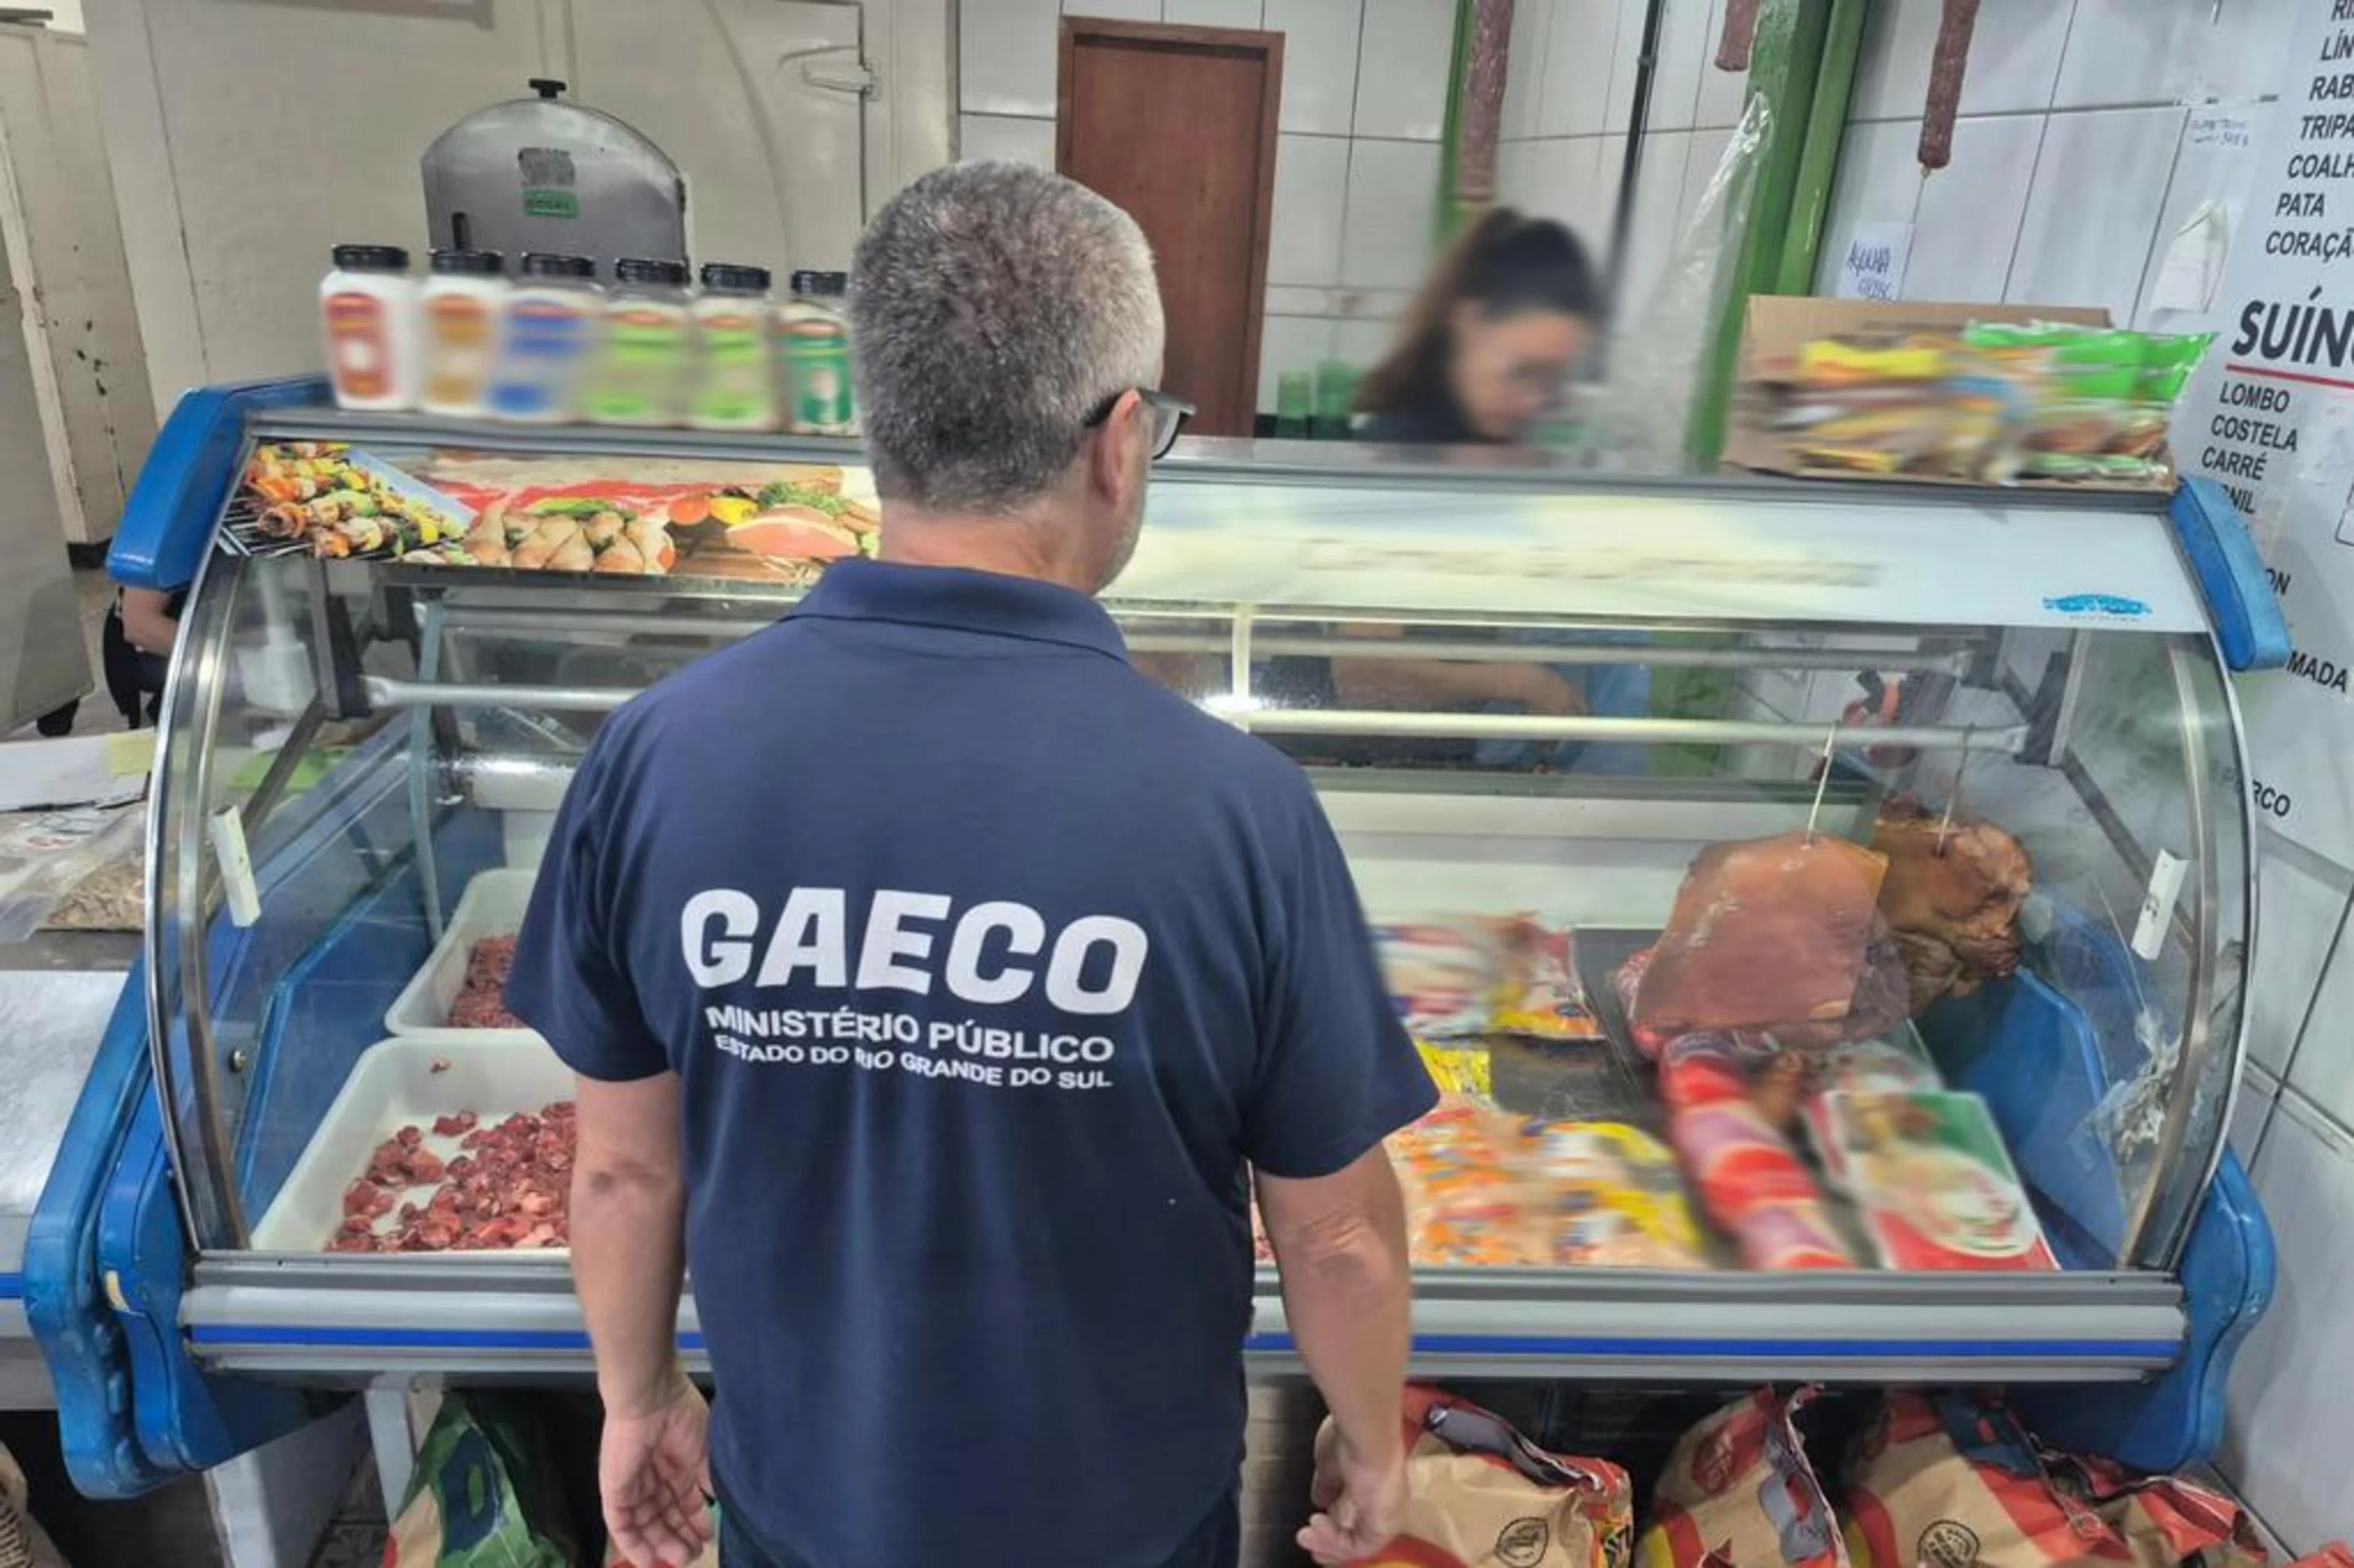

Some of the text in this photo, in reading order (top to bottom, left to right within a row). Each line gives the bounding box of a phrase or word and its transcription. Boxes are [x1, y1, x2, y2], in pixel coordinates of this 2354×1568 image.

[2276, 193, 2325, 217] PATA
[2231, 285, 2354, 368] SUÍN
[2220, 382, 2290, 413] LOMBO
[2211, 415, 2298, 452] COSTELA
[2201, 446, 2267, 481] CARRÉ
[2222, 484, 2255, 515] NIL
[2287, 650, 2347, 693] MADA
[682, 886, 1149, 1014] GAECO
[706, 1004, 1114, 1064] MINISTÉRIO PÚBLICO
[714, 1034, 1113, 1089] ESTADO DO RIO GRANDE DO SUL
